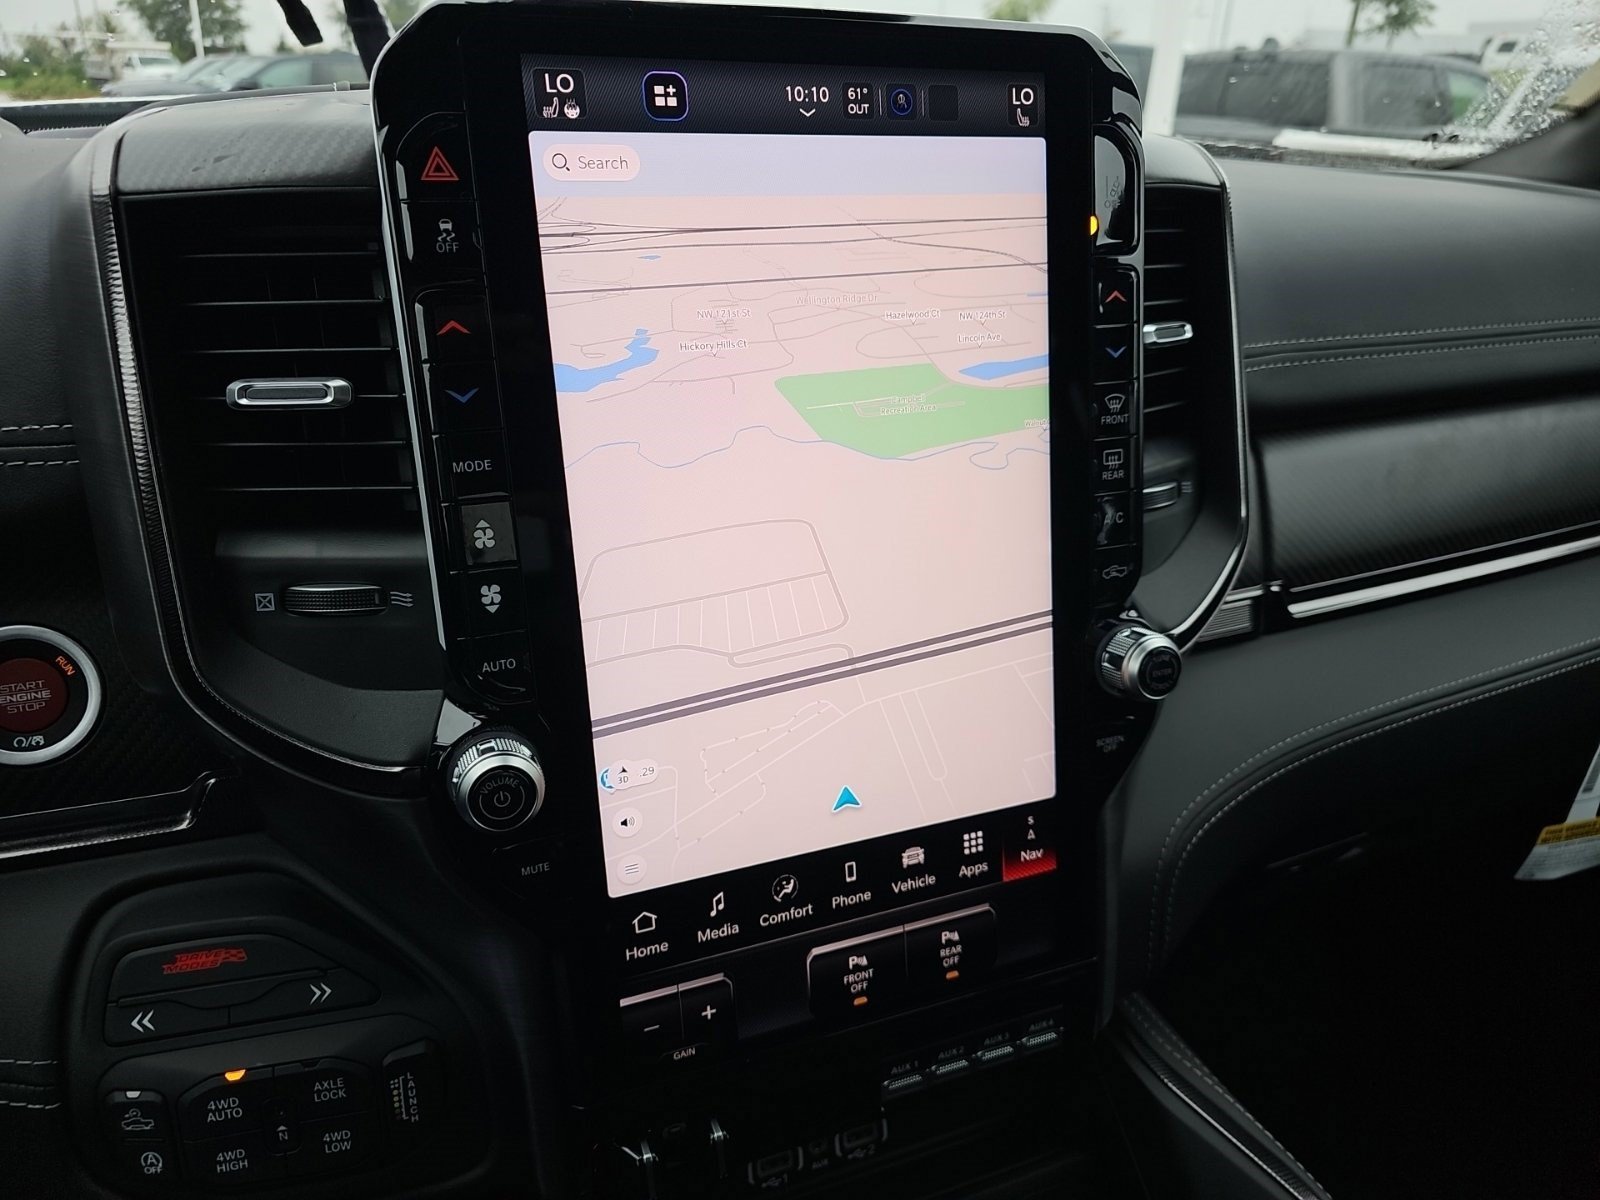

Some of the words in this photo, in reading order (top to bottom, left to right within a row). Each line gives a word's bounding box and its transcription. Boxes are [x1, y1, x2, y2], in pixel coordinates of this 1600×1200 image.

[544, 73, 575, 94] LO
[785, 85, 829, 103] 10:10
[847, 87, 869, 100] 61°
[1012, 88, 1034, 105] LO
[847, 103, 870, 115] OUT
[578, 155, 629, 172] Search
[436, 242, 460, 254] OFF
[696, 309, 713, 319] NW
[715, 309, 740, 318] 121st
[742, 308, 751, 318] St
[885, 309, 930, 319] Hazelwood
[931, 309, 940, 318] Ct
[959, 312, 973, 321] NW
[998, 310, 1006, 319] St
[958, 334, 986, 343] Lincoln
[987, 333, 1001, 342] Ave
[679, 341, 715, 353] Hickory
[716, 340, 735, 350] Hills
[737, 339, 747, 349] Ct
[920, 402, 937, 412] Area
[1101, 413, 1129, 425] FRONT
[452, 459, 493, 474] MODE
[1102, 470, 1125, 481] REAR
[55, 655, 76, 676] RUN
[482, 658, 516, 673] AUTO
[0, 680, 46, 694] START
[0, 690, 52, 704] ENGINE
[7, 701, 46, 714] STOP
[480, 776, 520, 795] VOLUME
[618, 775, 629, 784] 3D
[1020, 848, 1044, 862] Nav
[521, 862, 550, 876] MUTE
[958, 861, 989, 878] Apps
[891, 873, 936, 894] Vehicle
[831, 890, 872, 910] Phone
[759, 904, 814, 927] Comfort
[697, 922, 740, 943] Media
[179, 950, 224, 963] DRIVE
[625, 941, 669, 961] Home
[939, 944, 963, 958] REAR
[165, 960, 220, 973] MODES
[942, 955, 960, 968] OFF
[843, 968, 874, 985] FRONT
[850, 980, 869, 993] OFF
[1028, 1020, 1048, 1032] AUX
[983, 1034, 1003, 1047] AUX
[673, 1047, 697, 1061] GAIN
[937, 1048, 957, 1060] AUX
[890, 1063, 911, 1076] AUX
[313, 1077, 345, 1092] AXLE
[314, 1088, 347, 1102] LOCK
[407, 1072, 419, 1122] LAUNCH
[207, 1097, 240, 1112] 4WD
[207, 1107, 243, 1123] AUTO
[278, 1130, 289, 1142] N
[323, 1129, 351, 1143] 4WD
[324, 1140, 352, 1153] LOW
[216, 1148, 246, 1163] 4WD
[144, 1165, 162, 1175] OFF
[216, 1159, 249, 1174] HIGH
